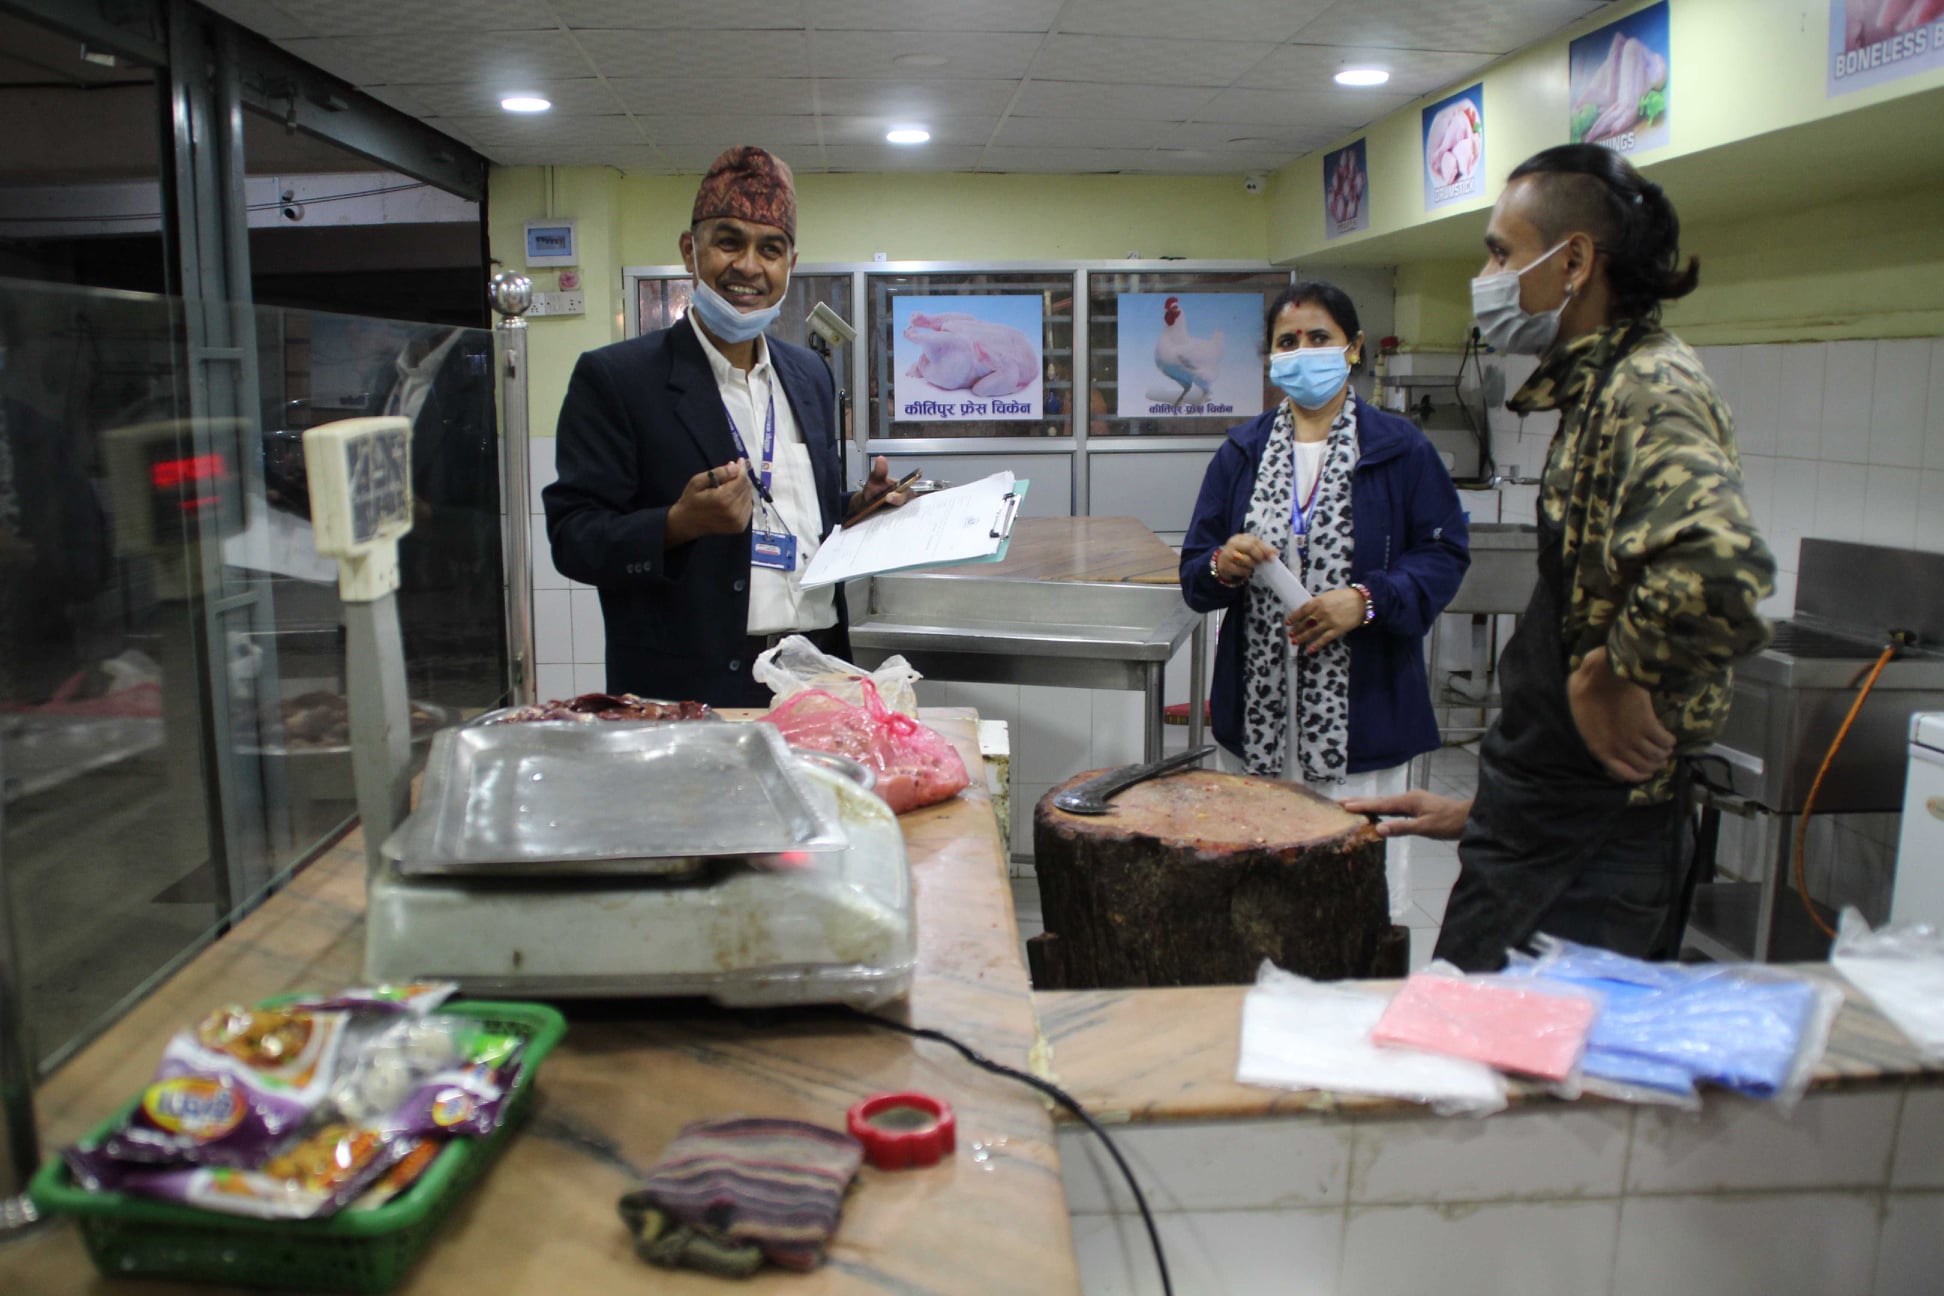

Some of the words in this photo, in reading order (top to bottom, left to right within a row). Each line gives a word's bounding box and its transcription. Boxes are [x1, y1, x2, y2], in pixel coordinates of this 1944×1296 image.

[1834, 27, 1928, 79] BONELESS
[904, 400, 956, 417] कीर्तिपुर
[960, 400, 987, 416] फ्रेस
[991, 399, 1031, 414] चिकेन
